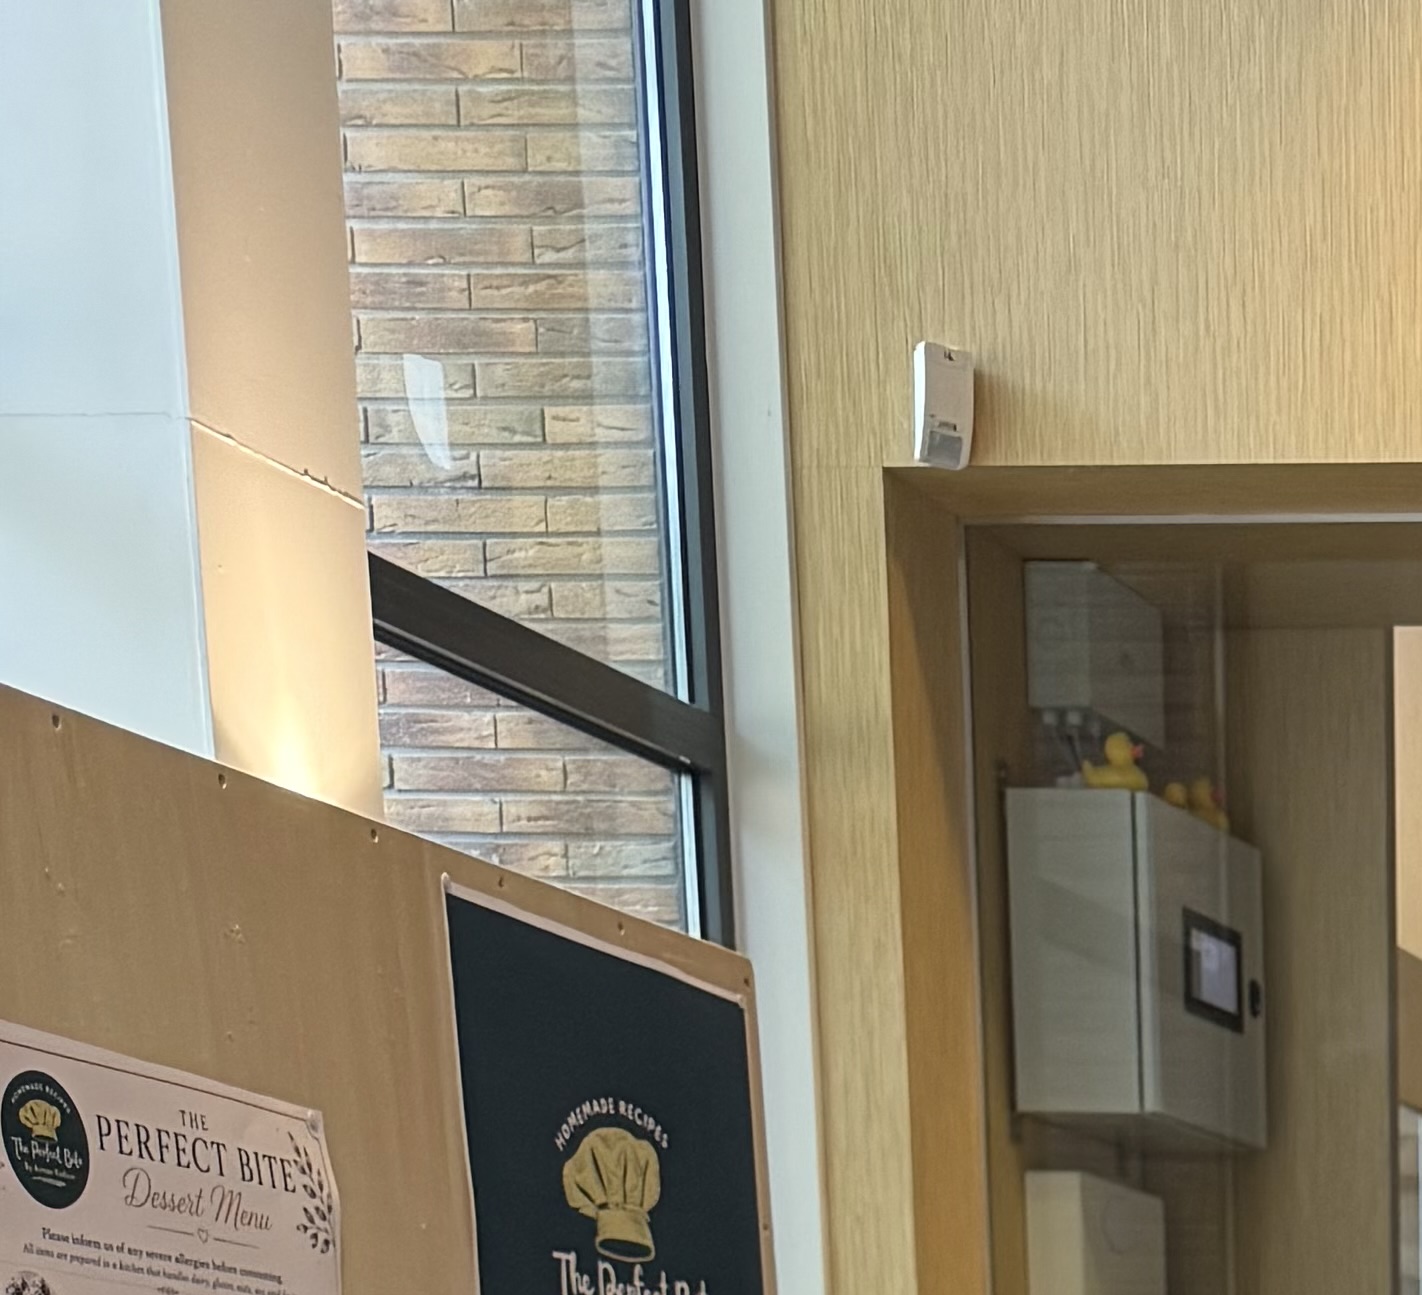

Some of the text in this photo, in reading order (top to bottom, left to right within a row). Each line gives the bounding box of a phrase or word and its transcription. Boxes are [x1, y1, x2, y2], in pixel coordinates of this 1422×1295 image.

[179, 1110, 209, 1131] THE
[555, 1097, 668, 1152] HOMEMADE RECIPES
[96, 1114, 296, 1194] PERFECT BITE
[122, 1167, 272, 1231] Dessert Menu
